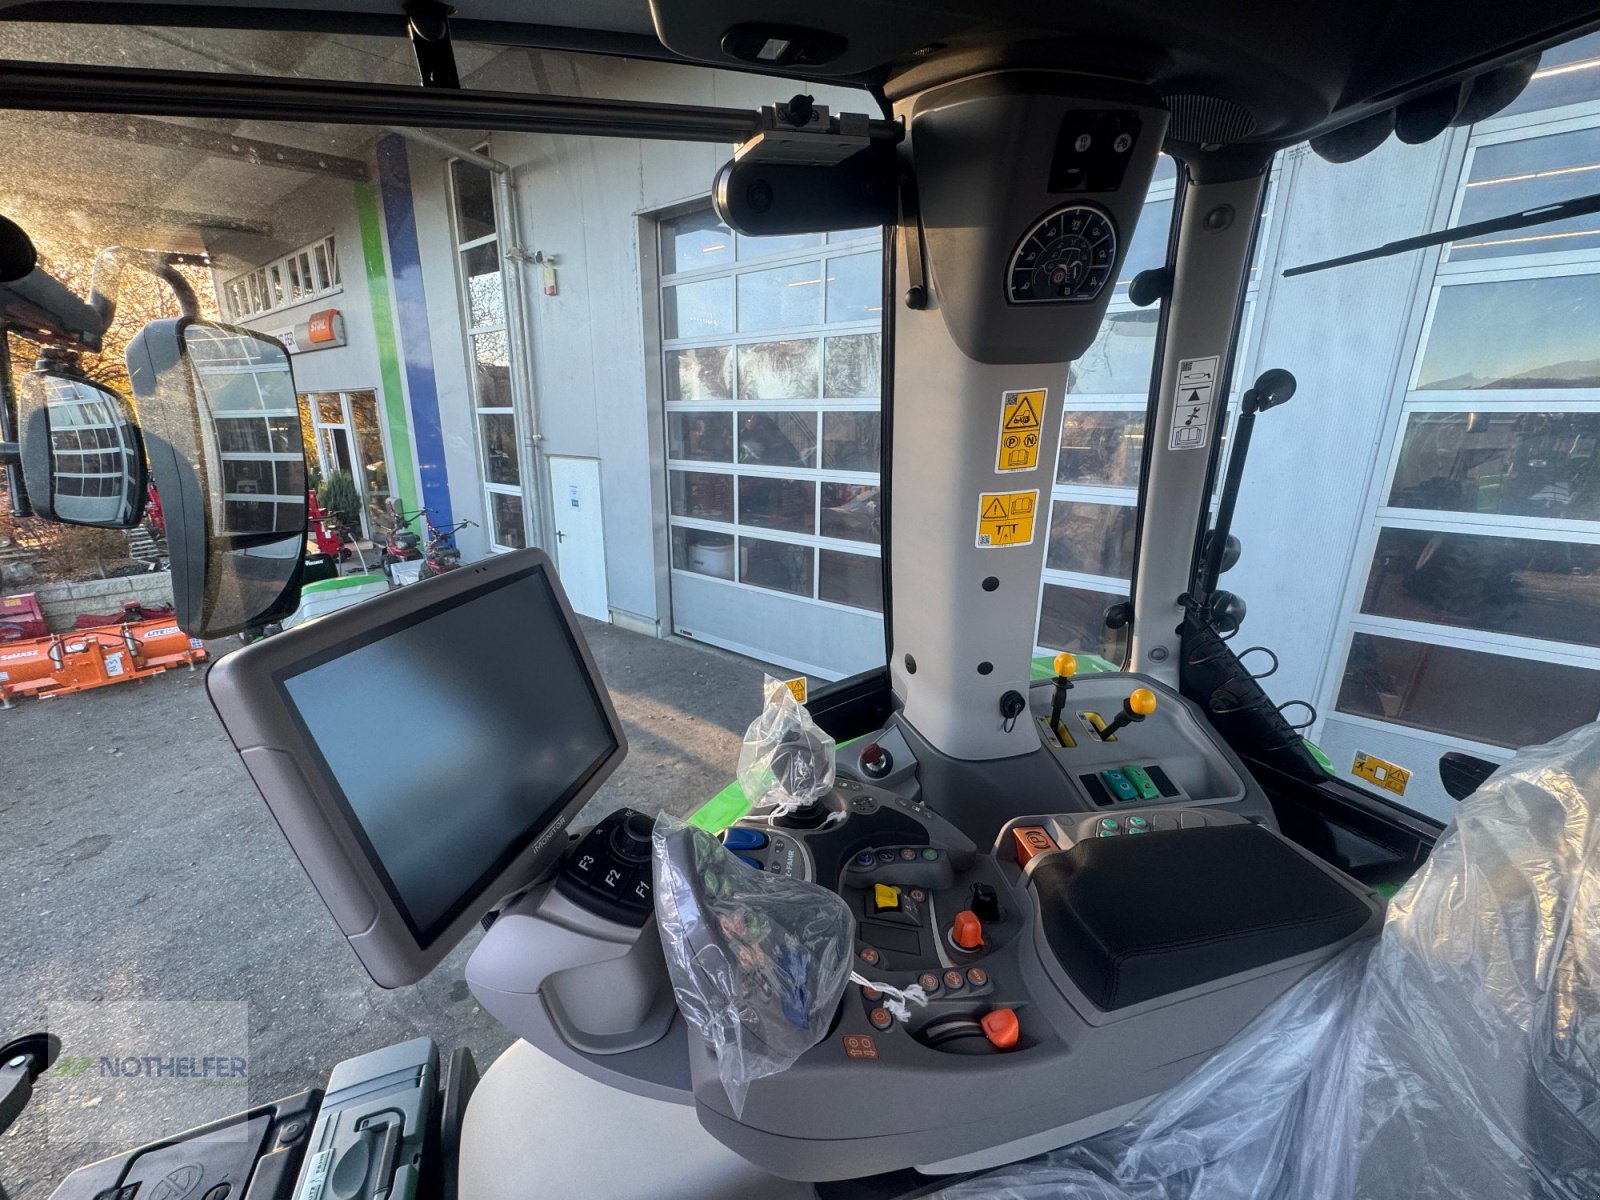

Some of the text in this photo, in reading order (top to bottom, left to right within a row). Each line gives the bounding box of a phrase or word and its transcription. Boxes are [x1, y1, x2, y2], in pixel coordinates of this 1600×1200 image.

[578, 855, 595, 871] F3
[604, 869, 621, 888] F2
[635, 880, 650, 899] F1
